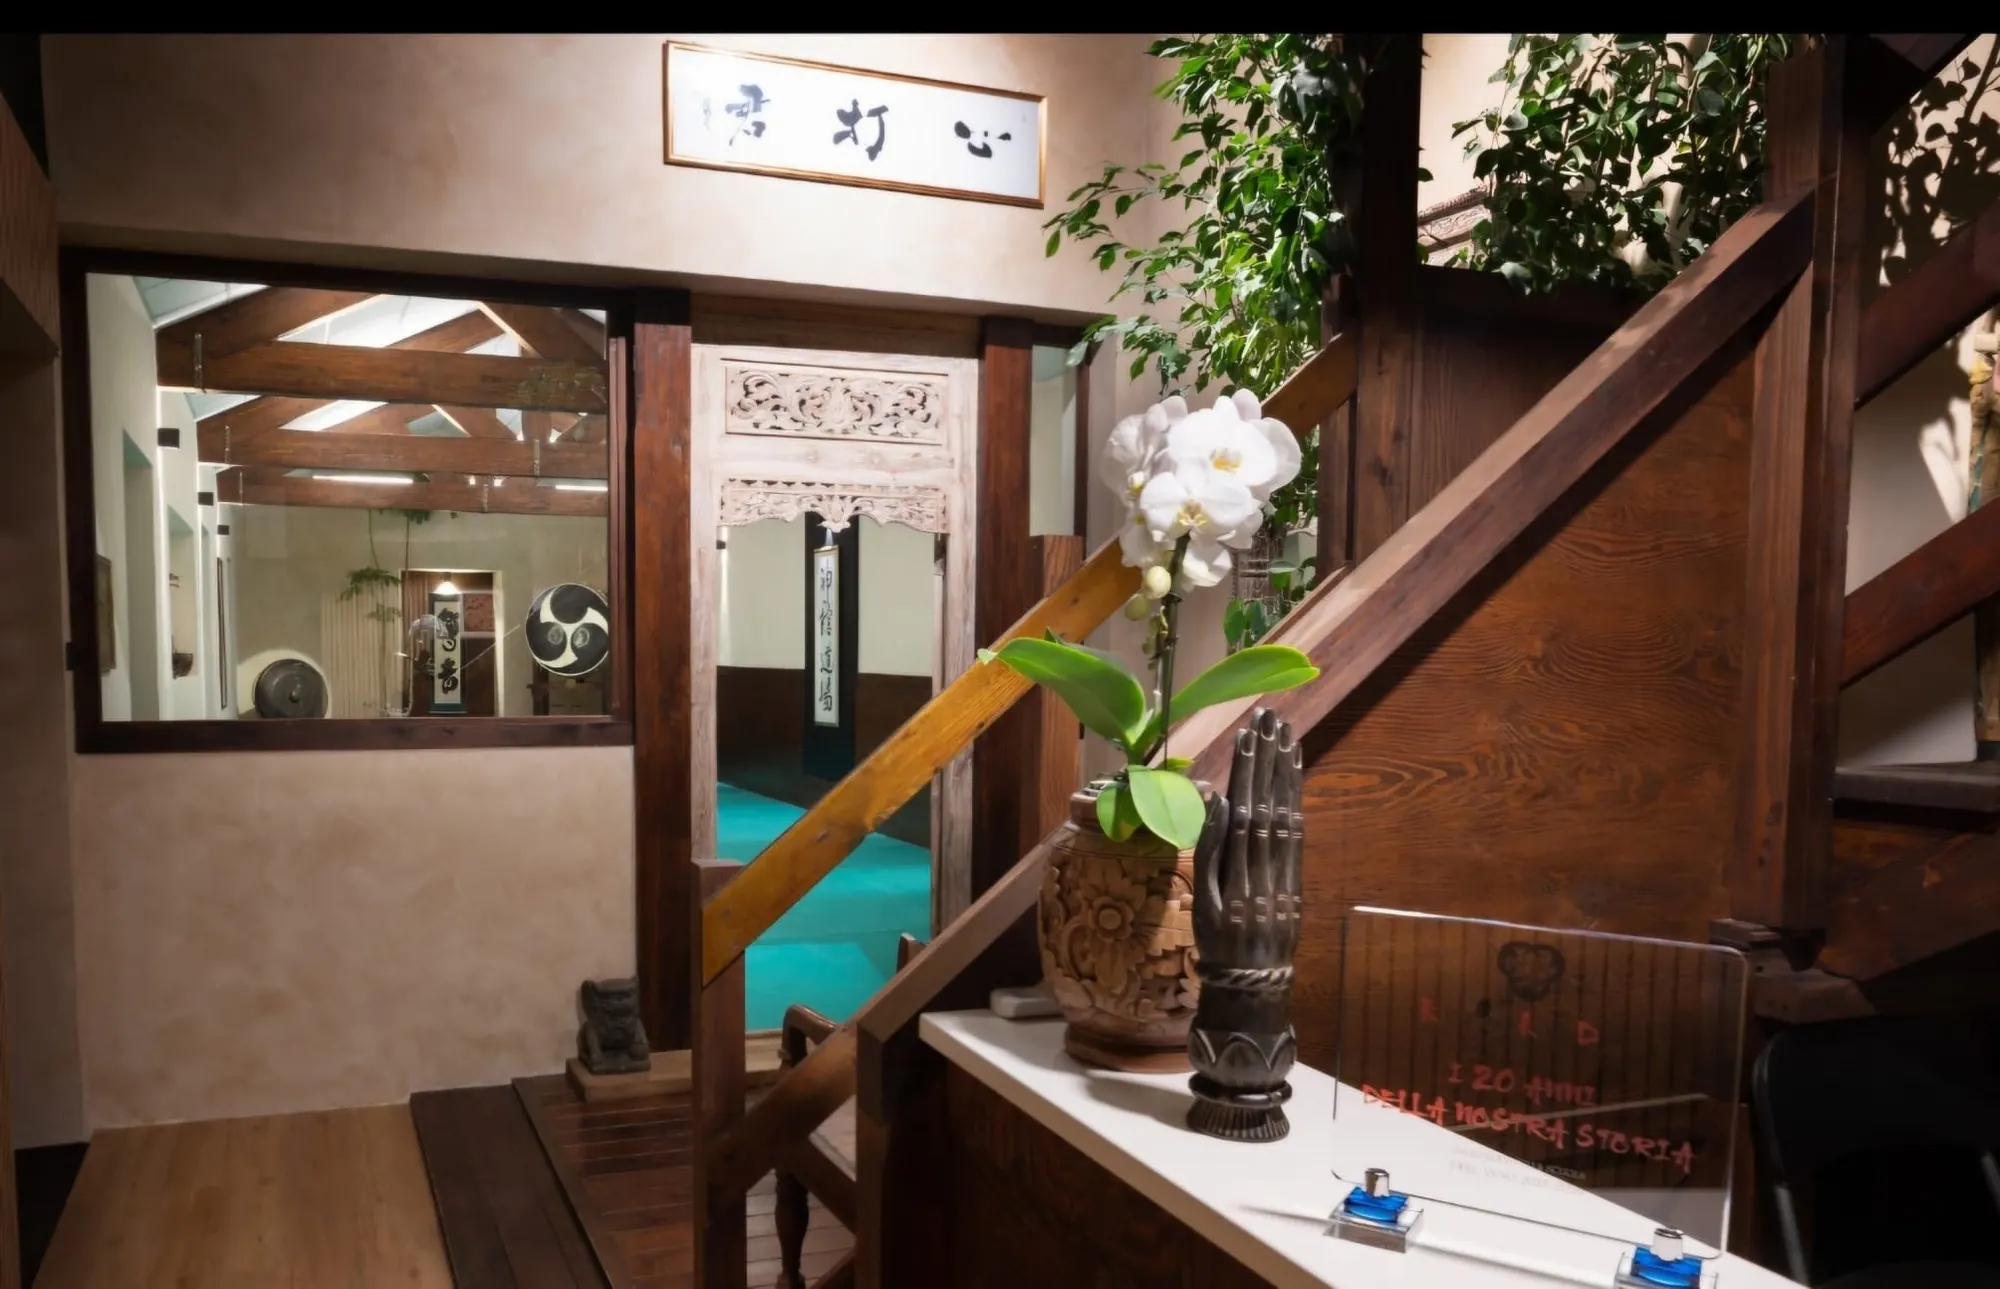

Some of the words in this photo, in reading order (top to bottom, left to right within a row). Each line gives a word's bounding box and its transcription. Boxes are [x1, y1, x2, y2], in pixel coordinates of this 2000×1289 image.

[1472, 1064, 1516, 1093] 20
[1362, 1083, 1449, 1126] DELLA
[1455, 1101, 1569, 1150] NOSTRA
[1576, 1123, 1695, 1174] STORIA
